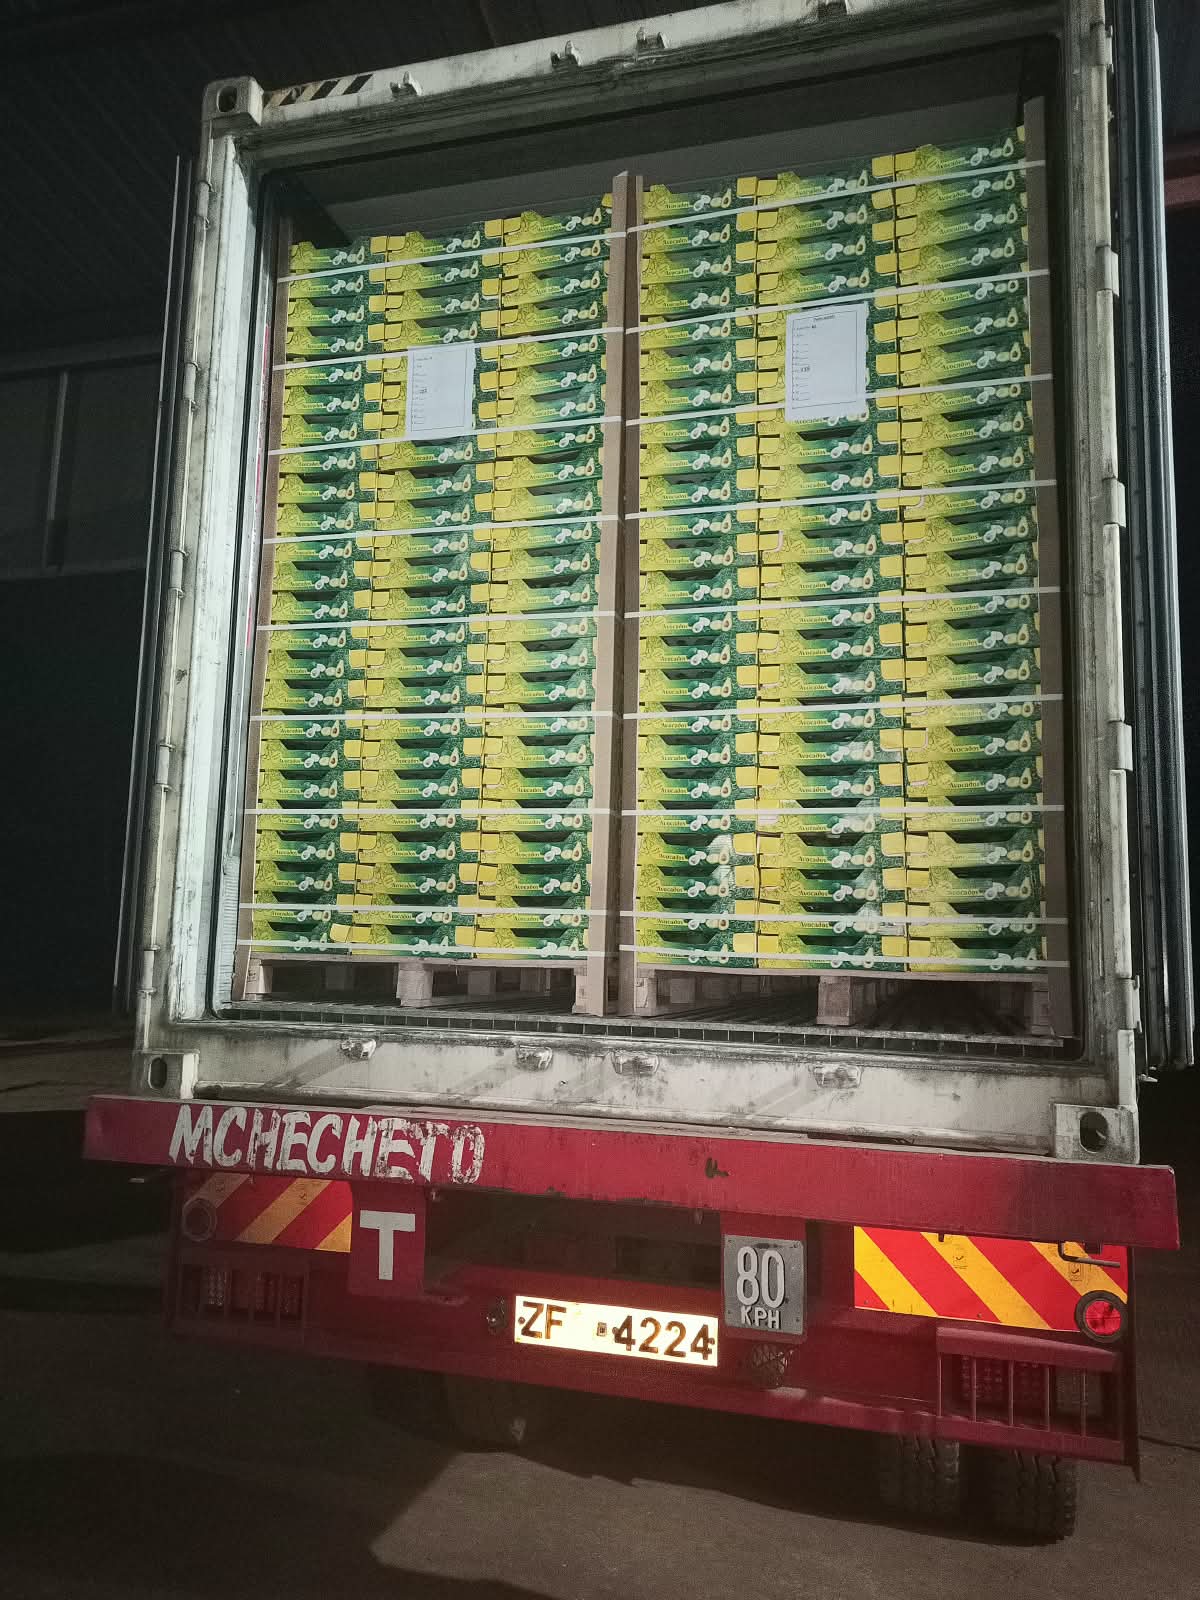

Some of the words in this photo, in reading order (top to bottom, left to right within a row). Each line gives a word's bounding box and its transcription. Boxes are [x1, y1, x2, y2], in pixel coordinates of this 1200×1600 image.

[359, 1209, 416, 1281] T
[736, 1246, 785, 1308] 80
[521, 1301, 567, 1339] ZF
[614, 1315, 712, 1360] 4224
[740, 1306, 781, 1330] KPH
